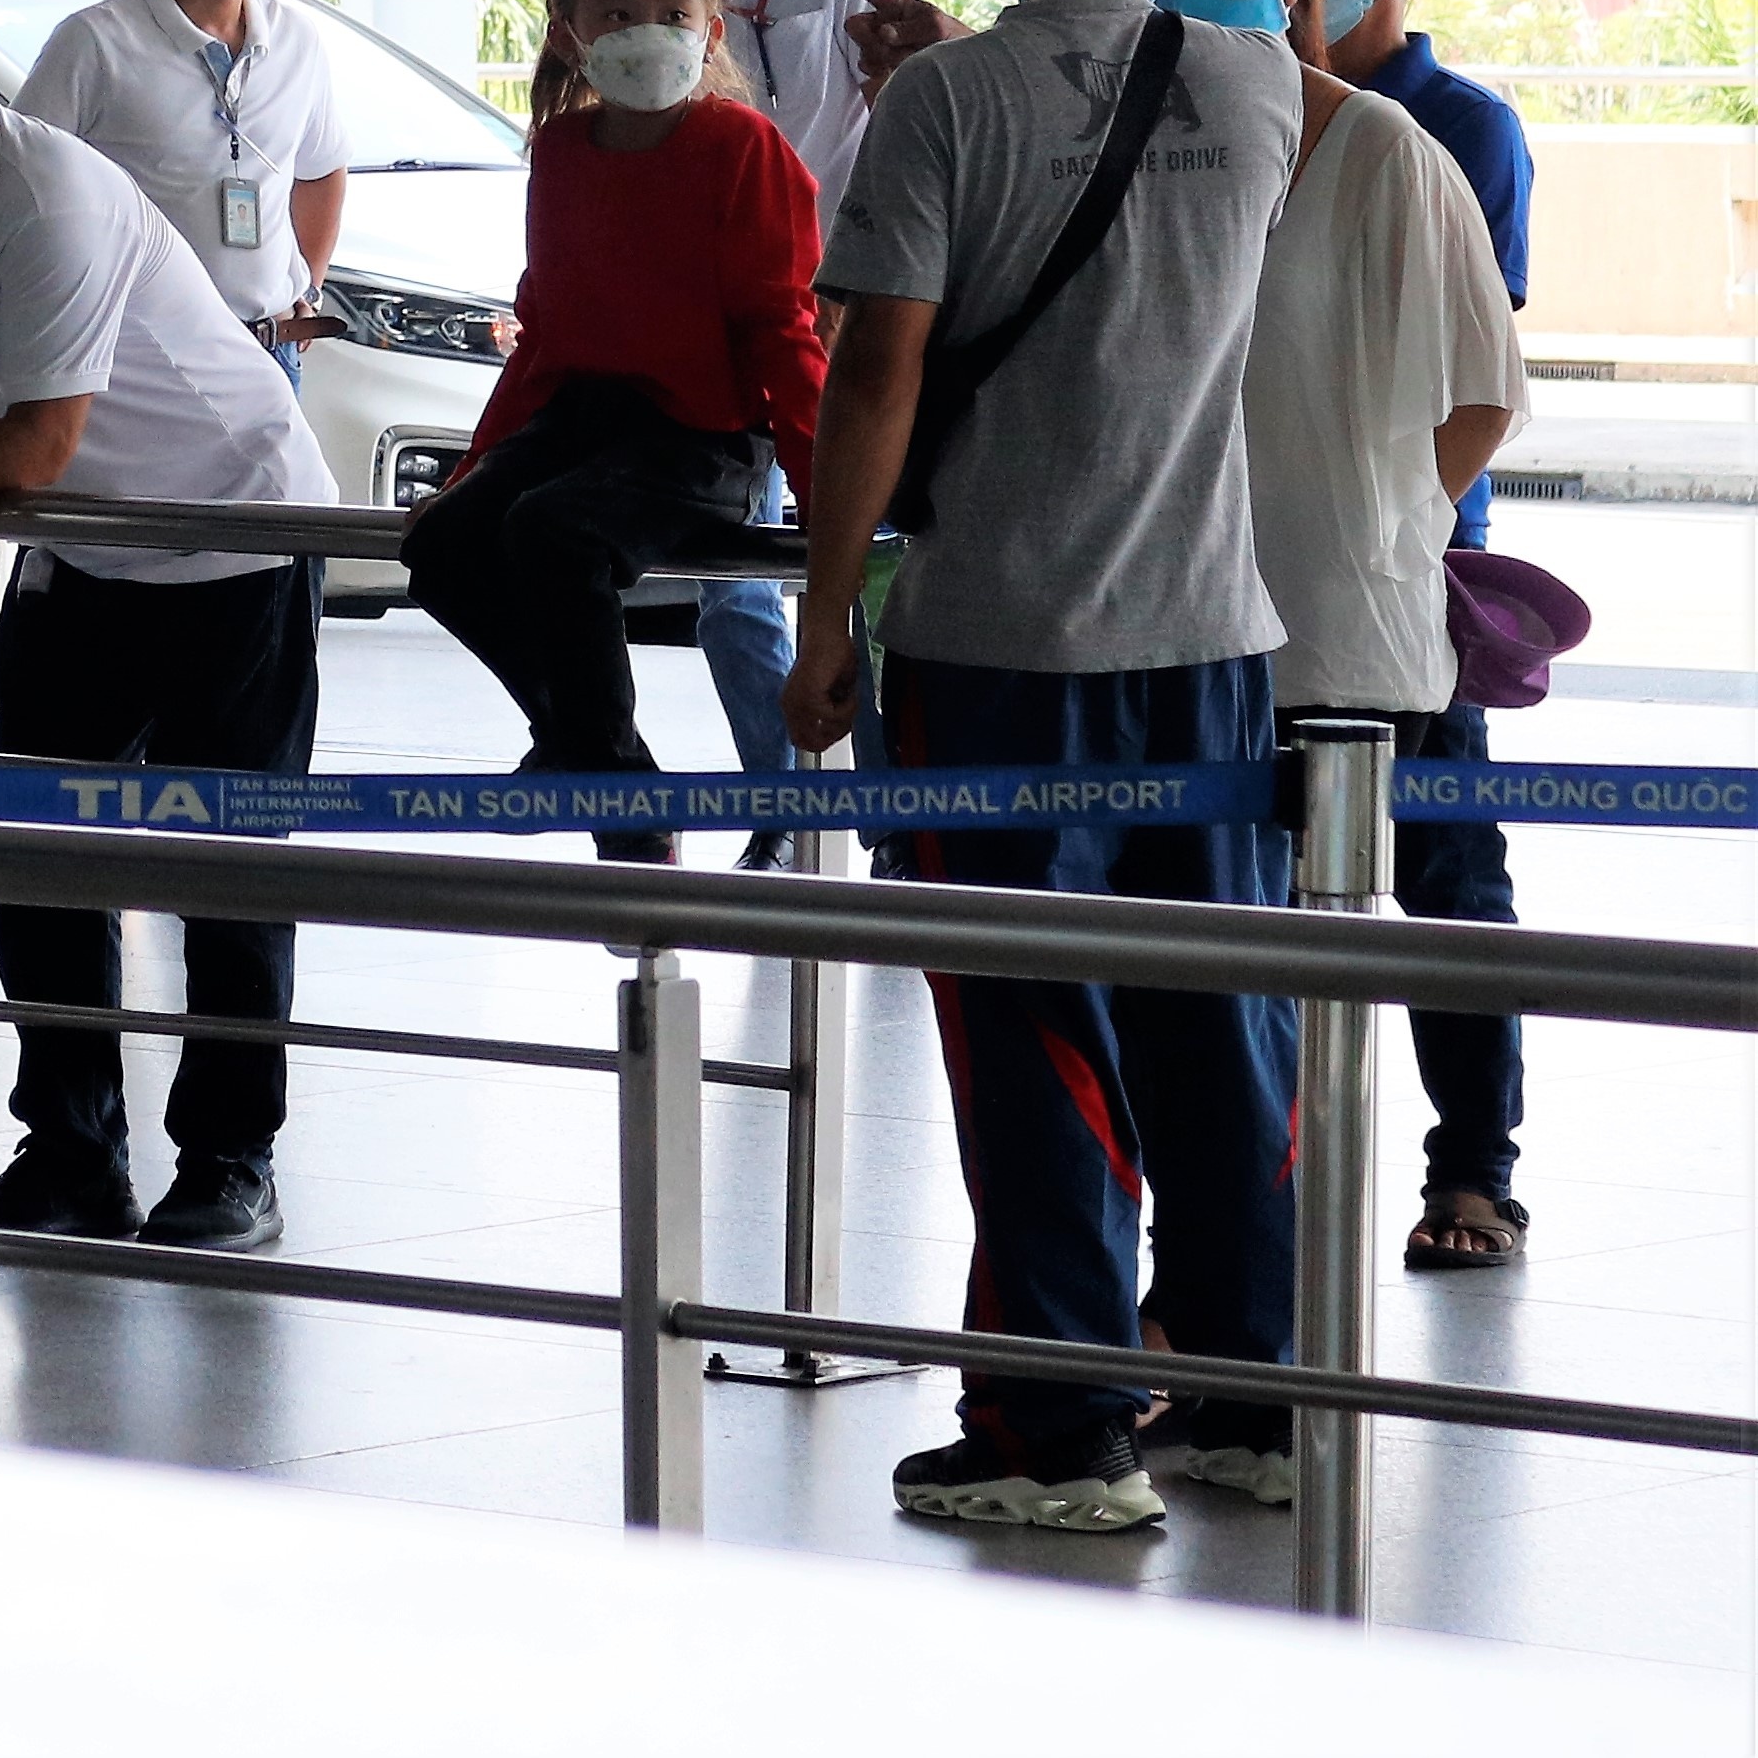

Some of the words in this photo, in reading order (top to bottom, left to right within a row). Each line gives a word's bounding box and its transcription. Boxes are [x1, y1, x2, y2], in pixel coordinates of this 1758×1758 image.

[1167, 147, 1228, 171] DRIVE
[59, 779, 212, 823] TIA
[230, 797, 364, 811] INTERNATIONAL
[389, 789, 463, 819] TAN
[477, 789, 558, 818] SON
[571, 788, 675, 819] NHAT
[686, 785, 1001, 818] INTERNATIONAL
[1010, 779, 1188, 812] AIRPORT
[1474, 772, 1619, 811] KHÔNG
[231, 815, 304, 827] AIRPORT
